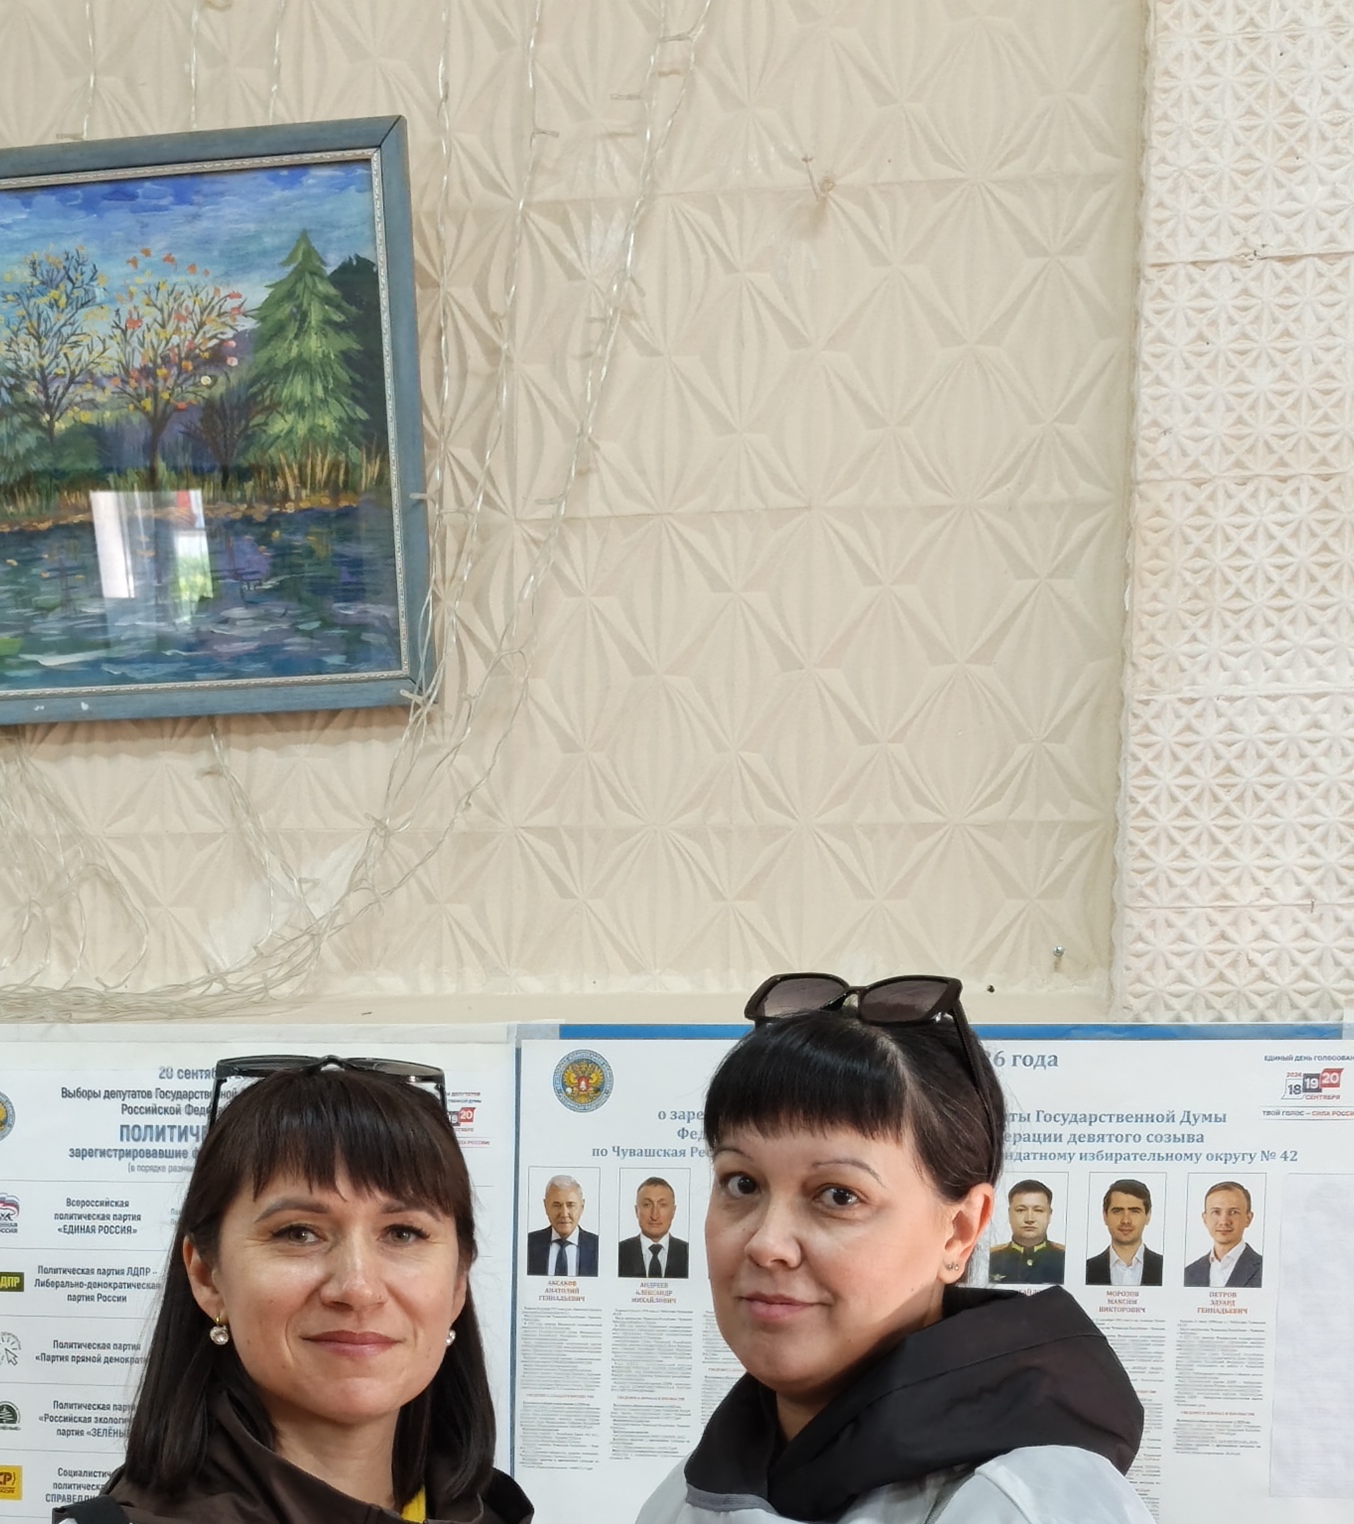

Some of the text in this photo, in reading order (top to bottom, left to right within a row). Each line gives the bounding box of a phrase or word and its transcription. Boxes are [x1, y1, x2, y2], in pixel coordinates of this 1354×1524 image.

[1010, 1052, 1059, 1070] года
[159, 1065, 174, 1079] 20
[1288, 1072, 1339, 1095] 18 19 20
[61, 1086, 152, 1101] Выборы депутатов
[121, 1102, 182, 1117] Российской
[1035, 1109, 1176, 1127] Государственной
[1179, 1110, 1228, 1127] Думы
[1067, 1131, 1205, 1146] девятого созыва
[68, 1147, 189, 1162] зарегистрировавшие
[592, 1147, 608, 1158] по
[612, 1145, 687, 1160] Чувашская
[1079, 1148, 1299, 1165] избирательному округу № 42
[65, 1196, 130, 1209] Всероссийская
[54, 1212, 142, 1224] политическая партия
[57, 1223, 138, 1235] «ЕДИНАЯ РОССИЯ»
[37, 1264, 151, 1278] Политическая партия ЛДПР
[67, 1292, 127, 1304] партия России
[53, 1339, 141, 1352] Политическая партия
[35, 1353, 102, 1365] «Партия прямой
[53, 1399, 111, 1411] Политическая
[38, 1413, 92, 1425] «Российская
[56, 1427, 85, 1439] партия
